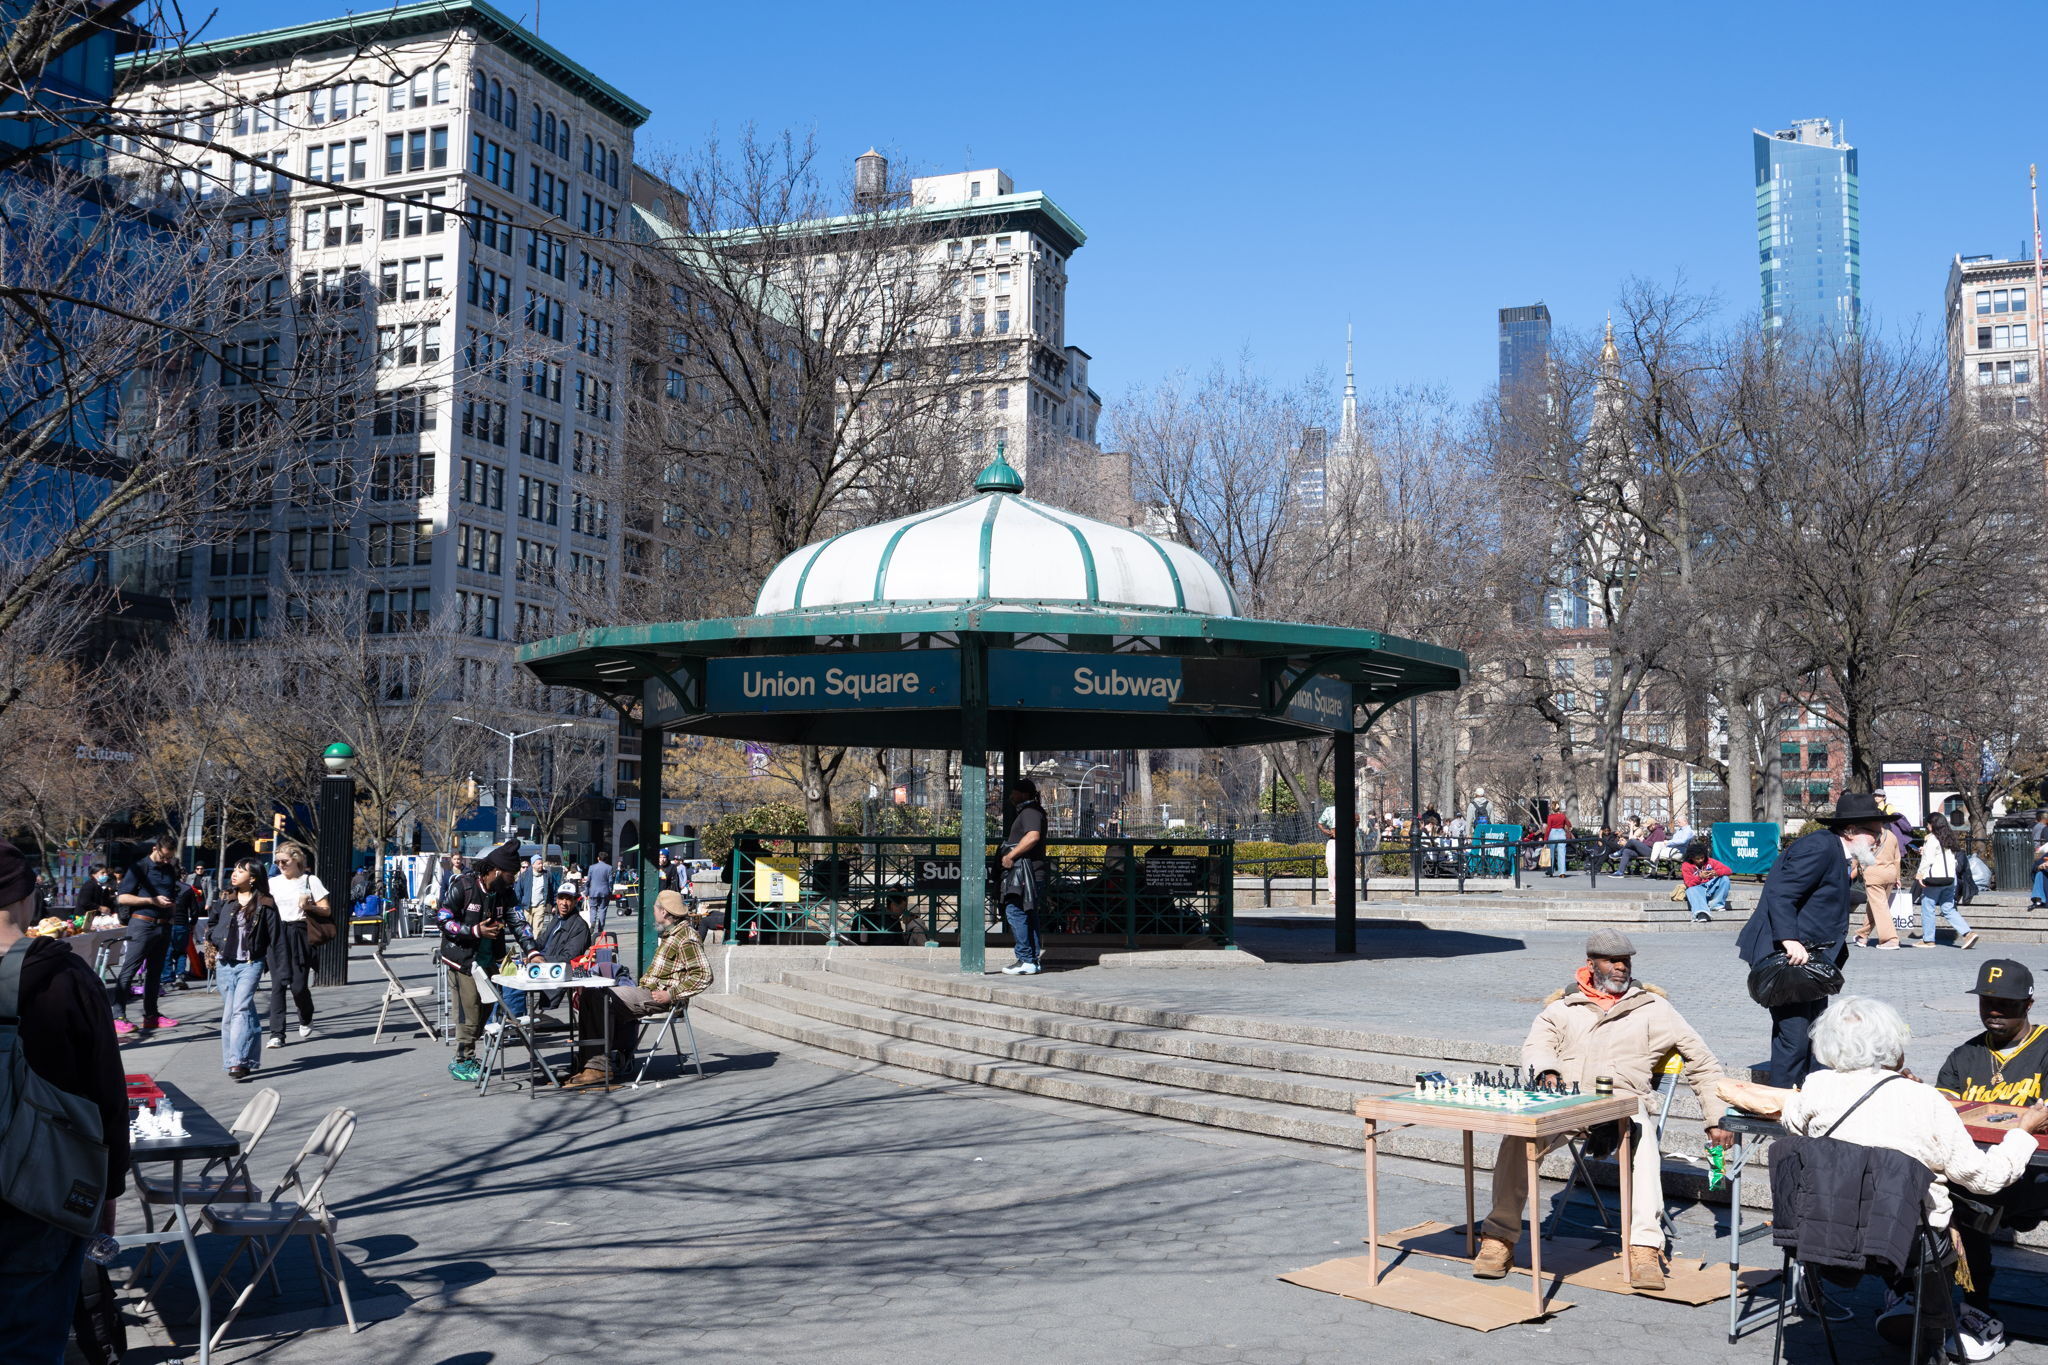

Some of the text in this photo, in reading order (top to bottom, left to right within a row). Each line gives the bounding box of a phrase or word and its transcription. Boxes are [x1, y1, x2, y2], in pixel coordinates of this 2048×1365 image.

[743, 667, 920, 702] Union Square
[1073, 666, 1181, 703] Subway
[1314, 687, 1343, 718] Square
[1731, 837, 1749, 847] UNION
[1736, 847, 1759, 859] SQUARE
[1987, 967, 2003, 983] P
